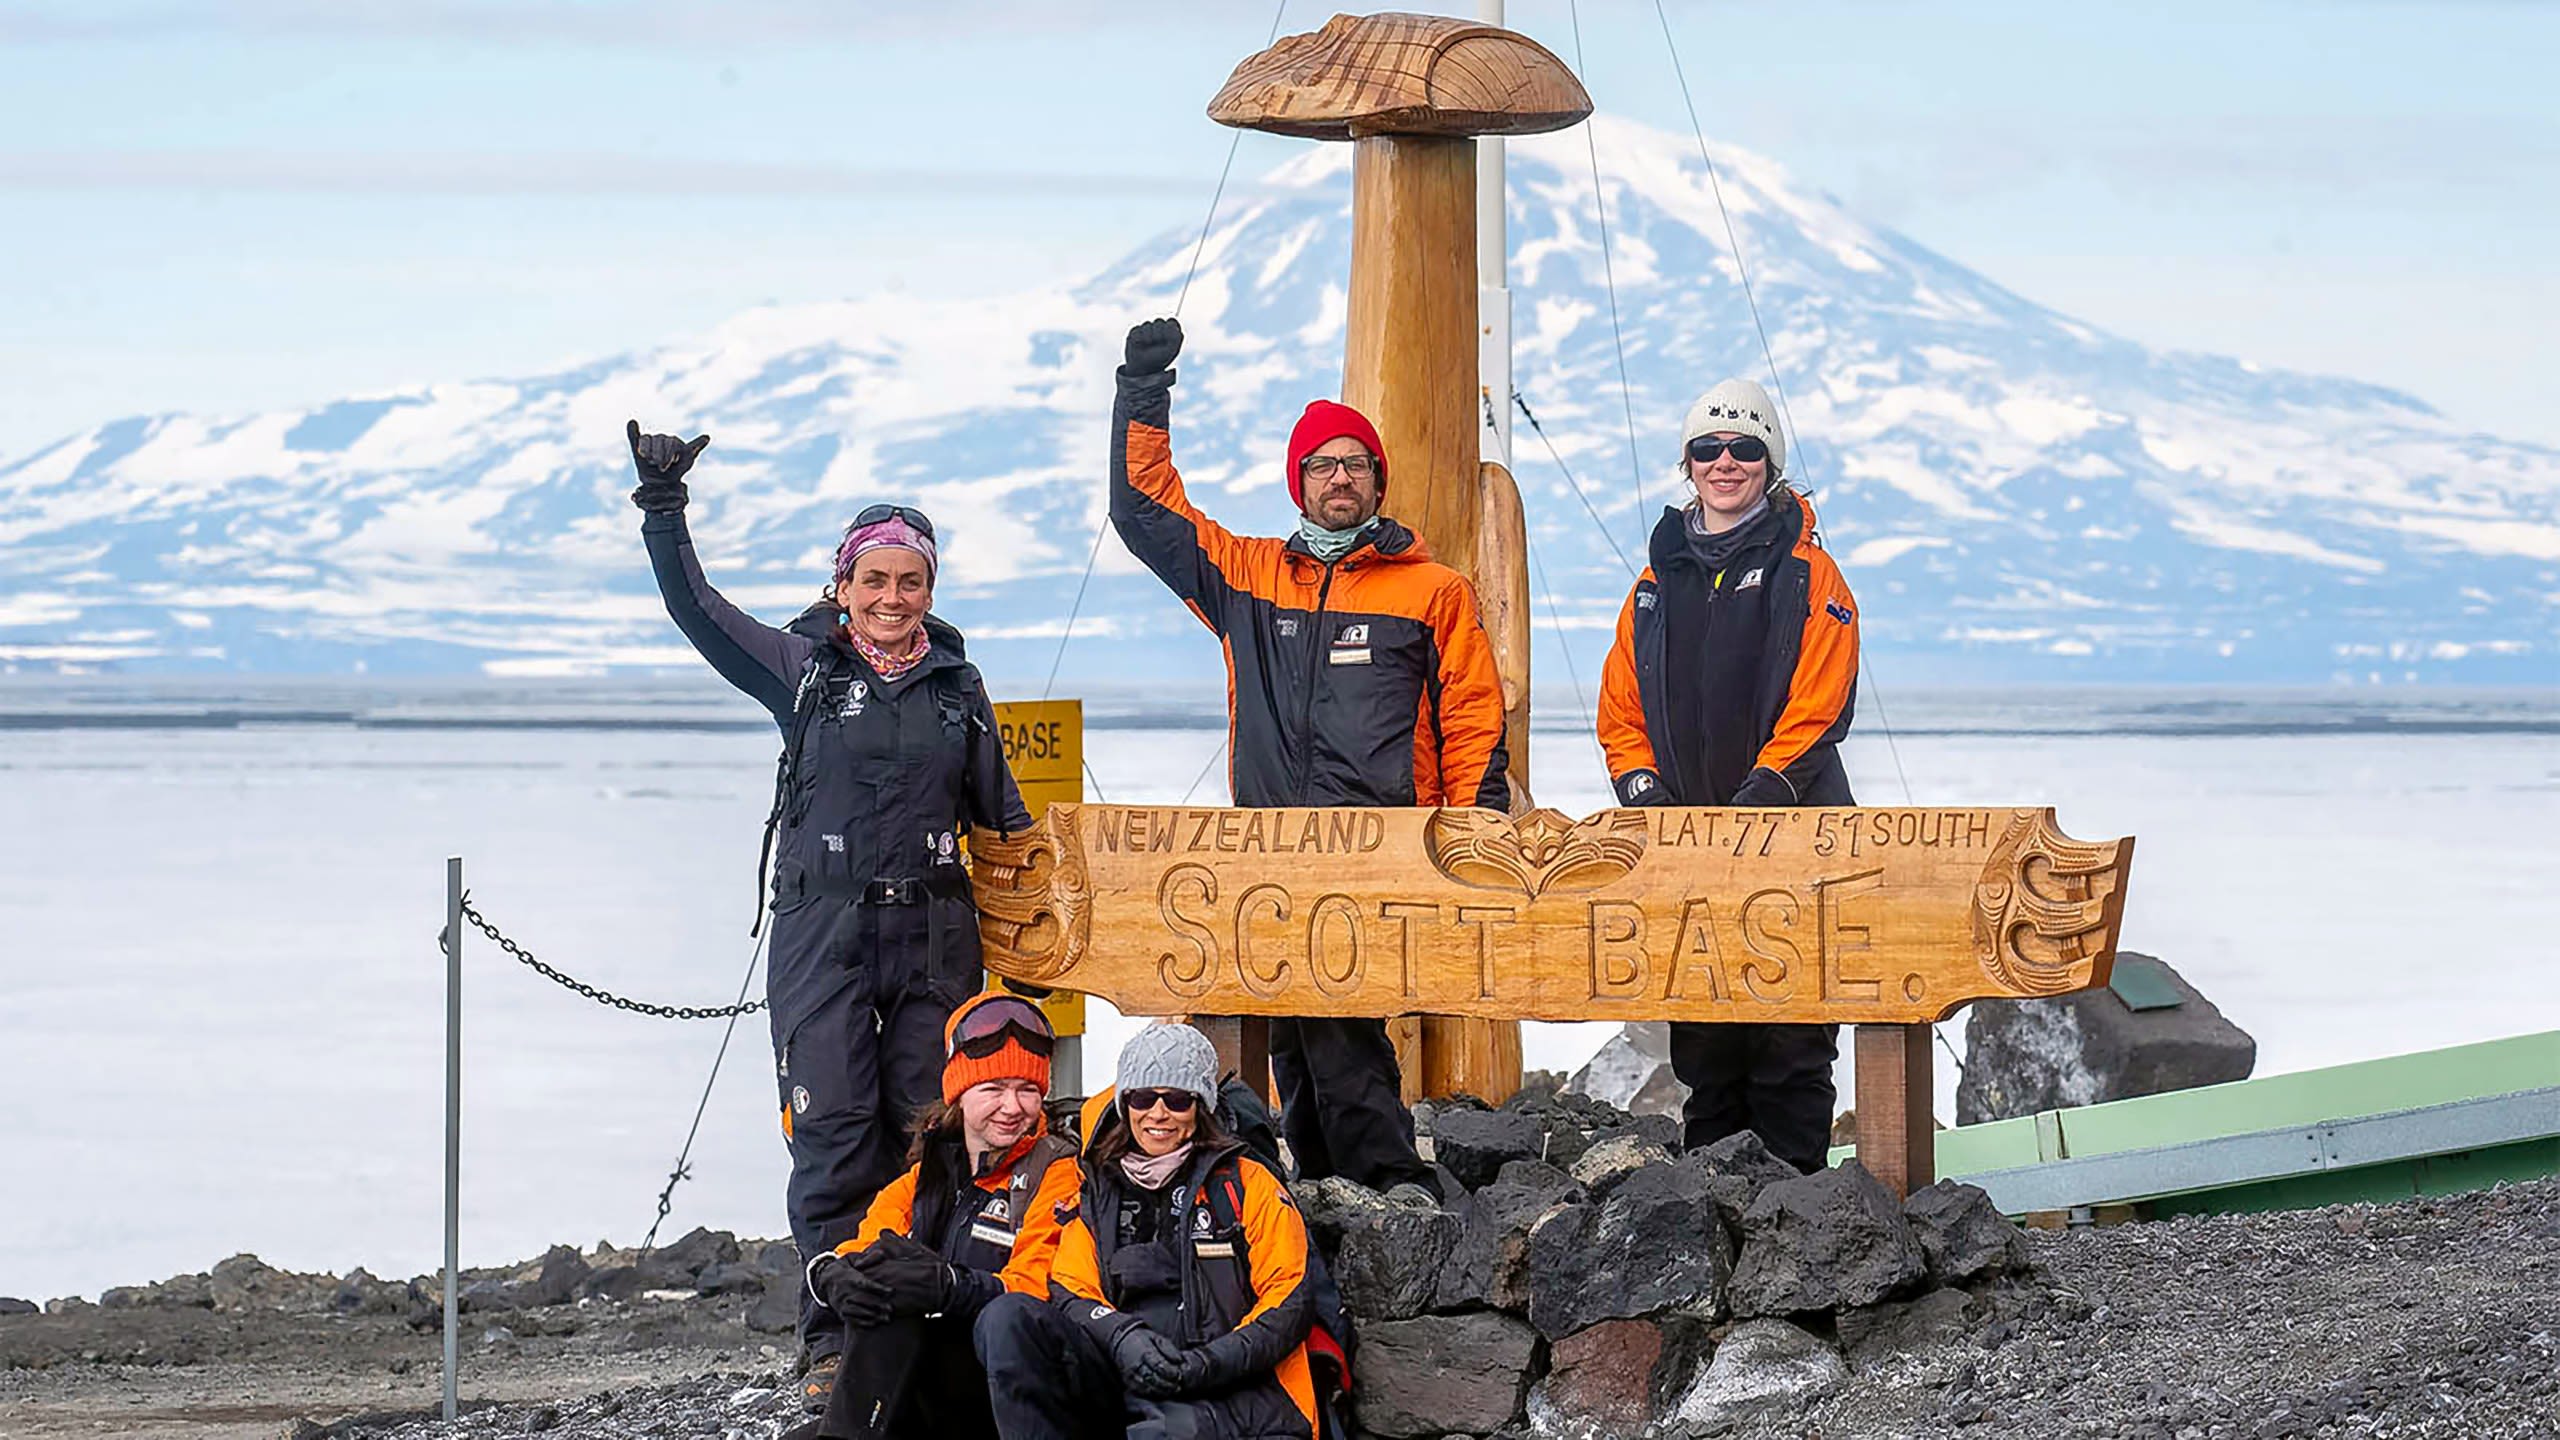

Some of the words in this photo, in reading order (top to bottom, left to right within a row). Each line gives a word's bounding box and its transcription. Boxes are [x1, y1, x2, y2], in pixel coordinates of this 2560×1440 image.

[1001, 722, 1061, 760] BASE
[1096, 810, 1179, 853] NEW
[1188, 811, 1385, 853] ZEALAND
[1814, 813, 1864, 857] 51
[1871, 812, 1990, 848] SOUTH
[1156, 862, 1516, 999] SCOTT
[1588, 868, 1926, 1002] BASE.
